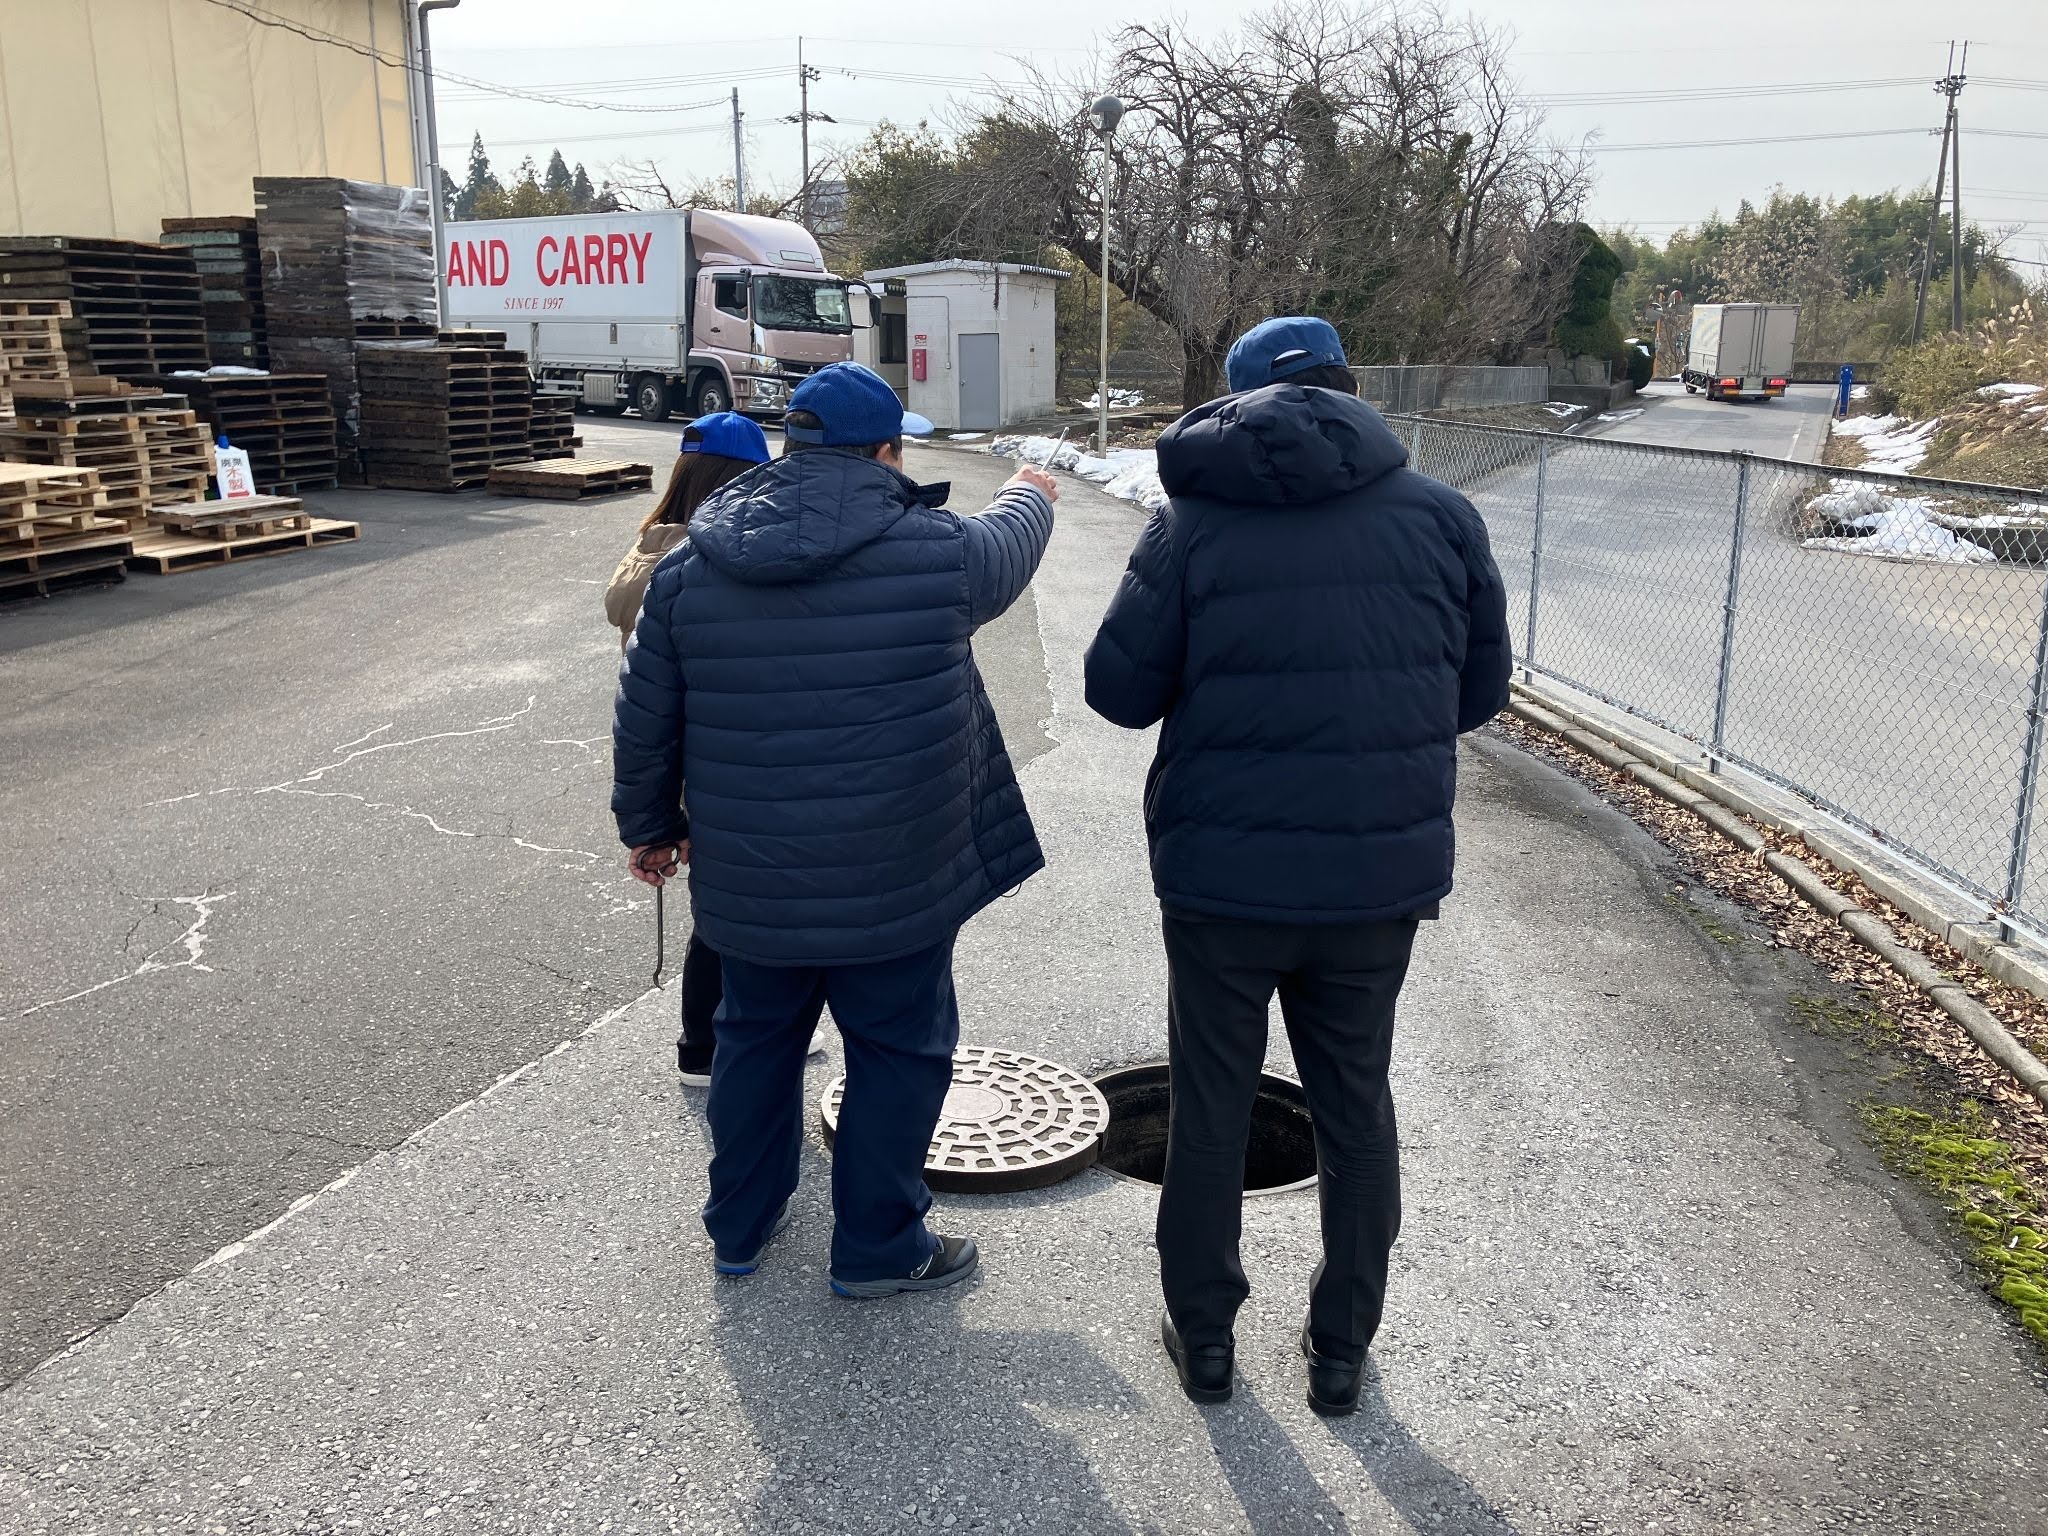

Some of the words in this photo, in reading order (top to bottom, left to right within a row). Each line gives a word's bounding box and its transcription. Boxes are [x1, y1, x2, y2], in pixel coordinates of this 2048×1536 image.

[536, 232, 653, 287] CARRY
[503, 297, 539, 310] SINCE
[542, 297, 564, 310] 1997
